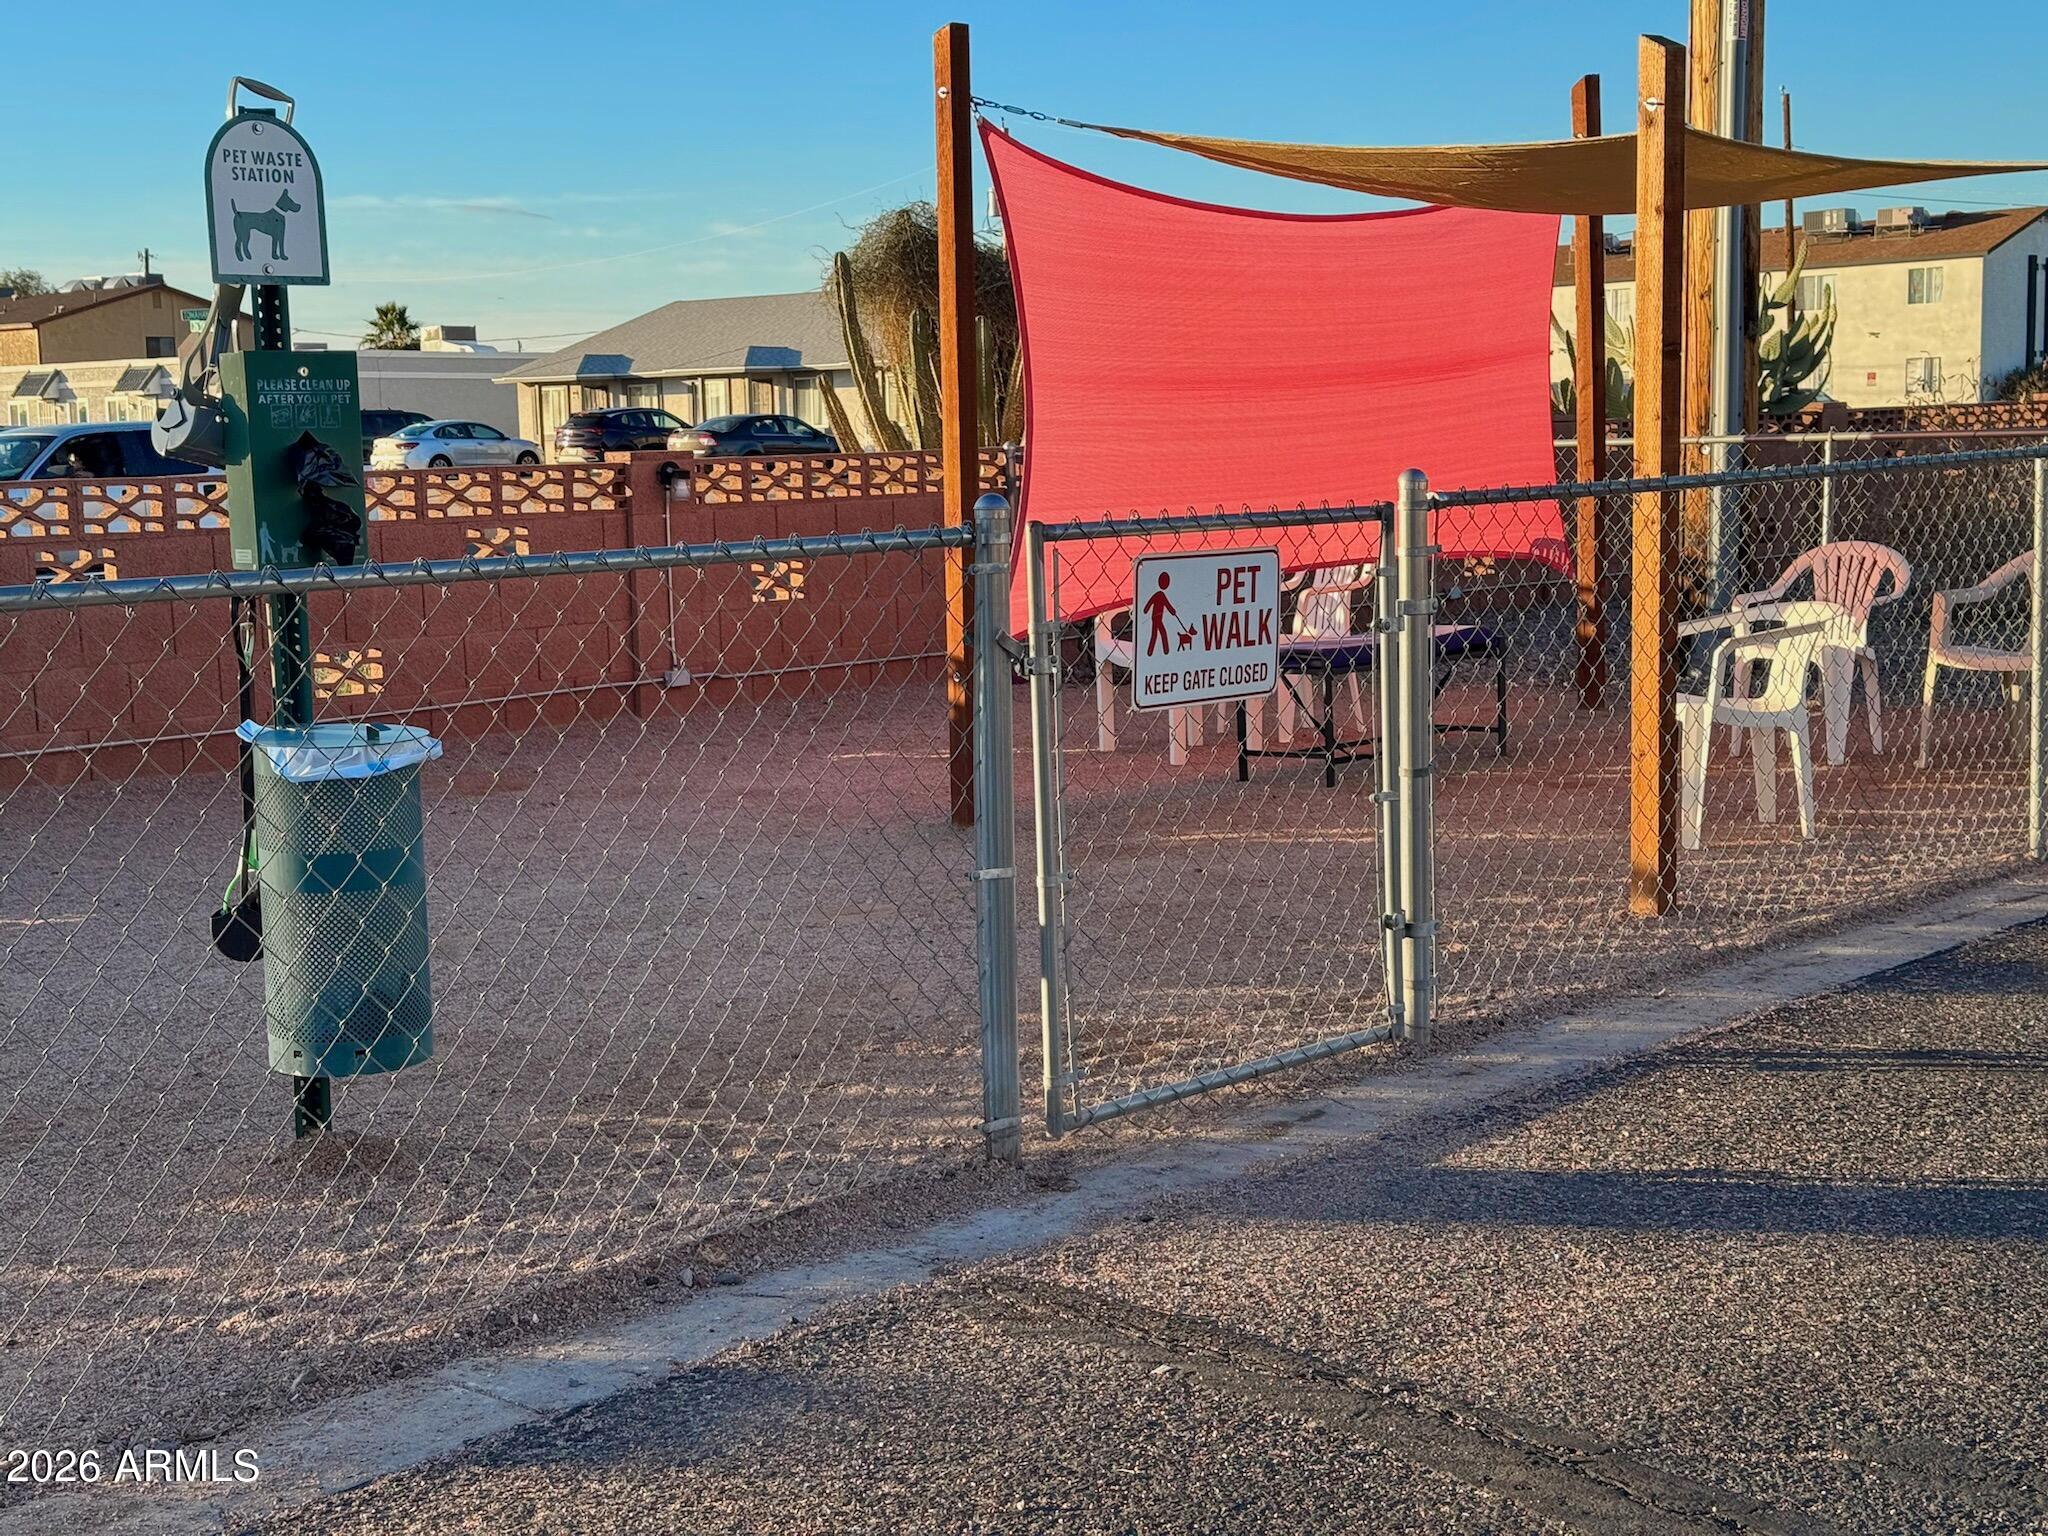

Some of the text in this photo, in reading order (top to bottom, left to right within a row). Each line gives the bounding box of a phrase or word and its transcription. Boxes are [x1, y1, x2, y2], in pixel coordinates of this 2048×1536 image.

[223, 148, 302, 167] PET WASTE
[231, 166, 294, 184] STATION
[257, 379, 351, 391] PLEASE CLEAN UP
[258, 394, 351, 404] AFTER YOUR PET
[1216, 565, 1261, 606] PET
[1202, 608, 1273, 651] WALK
[1144, 662, 1268, 695] KEEP GATE CLOSED
